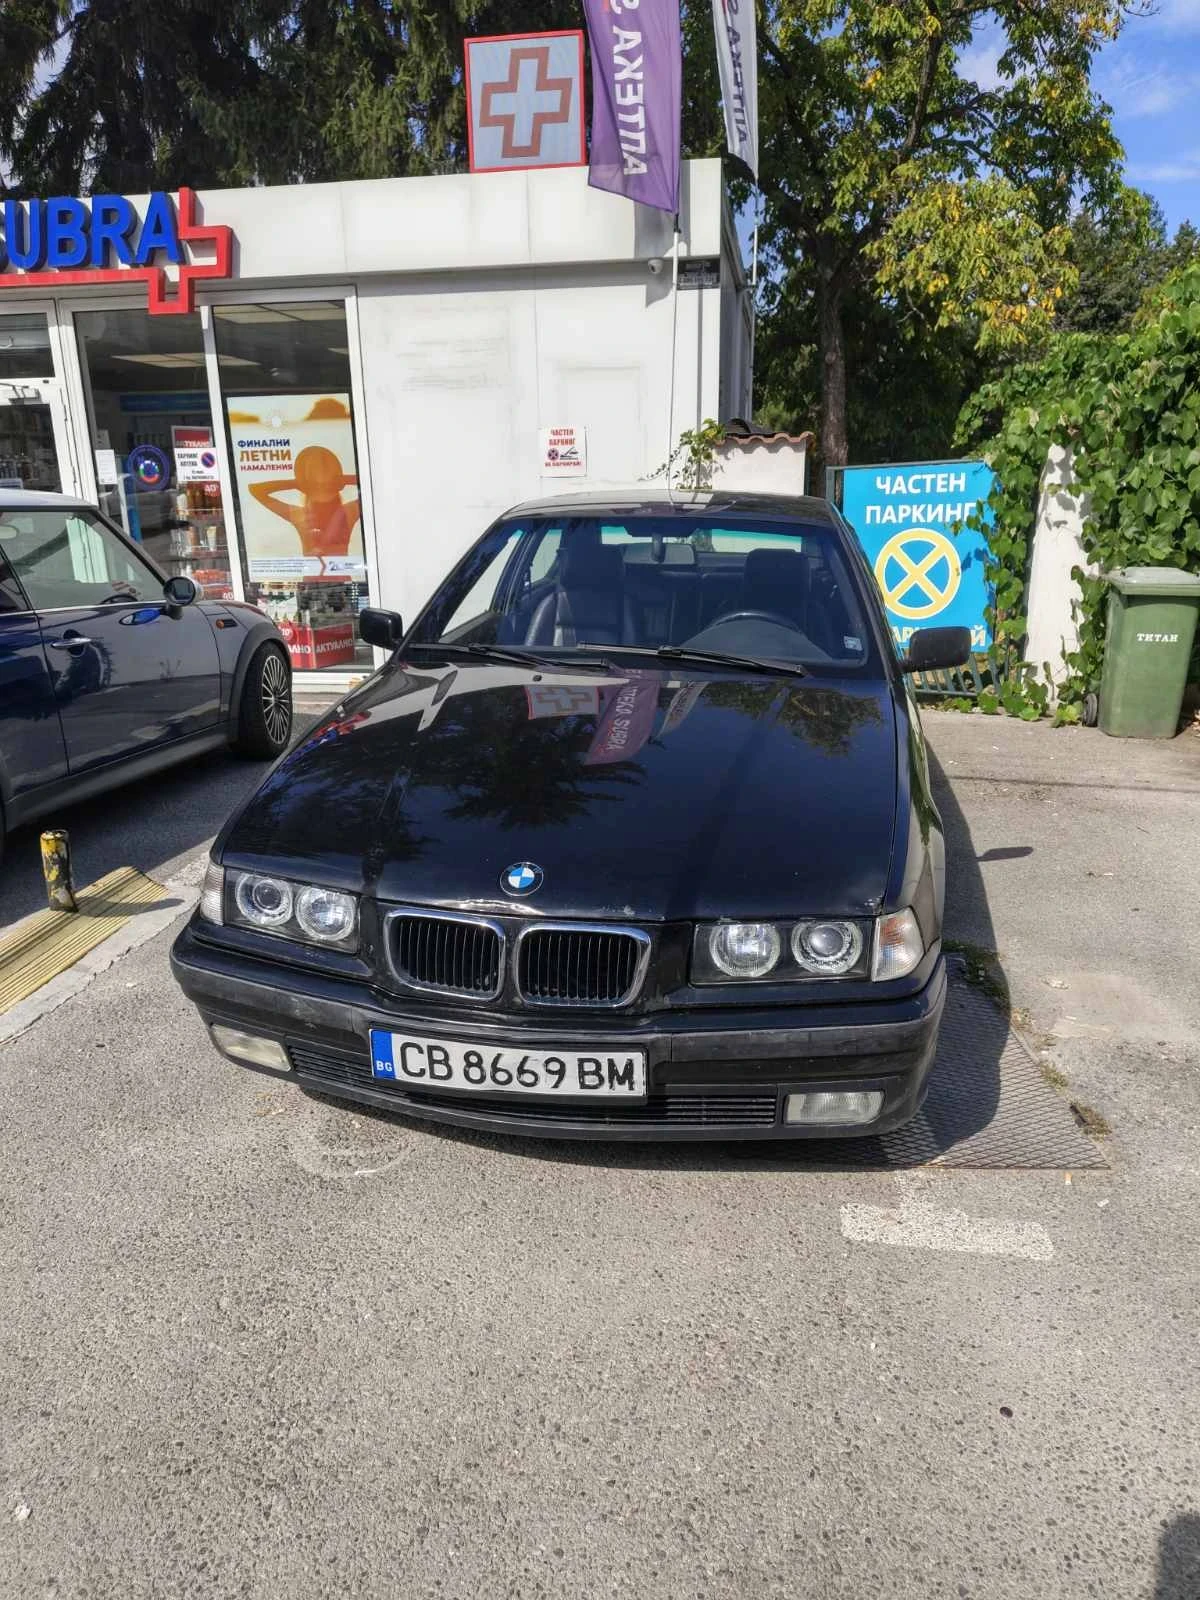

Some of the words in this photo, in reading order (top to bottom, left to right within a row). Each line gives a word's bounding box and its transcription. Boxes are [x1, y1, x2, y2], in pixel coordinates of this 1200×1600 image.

[0, 190, 182, 271] UBRA
[237, 438, 290, 448] ФИНАЛНИ
[239, 449, 292, 462] ЛЕТНИ
[240, 463, 293, 471] НАМАЛЕНИЯ
[875, 472, 967, 495] ЧАСТЕН
[865, 502, 977, 524] ПАРКИНГ
[1136, 632, 1179, 643] ТИТАН
[376, 1060, 393, 1073] BG
[400, 1041, 453, 1081] CB
[463, 1049, 566, 1089] 8669
[576, 1056, 635, 1091] BM
